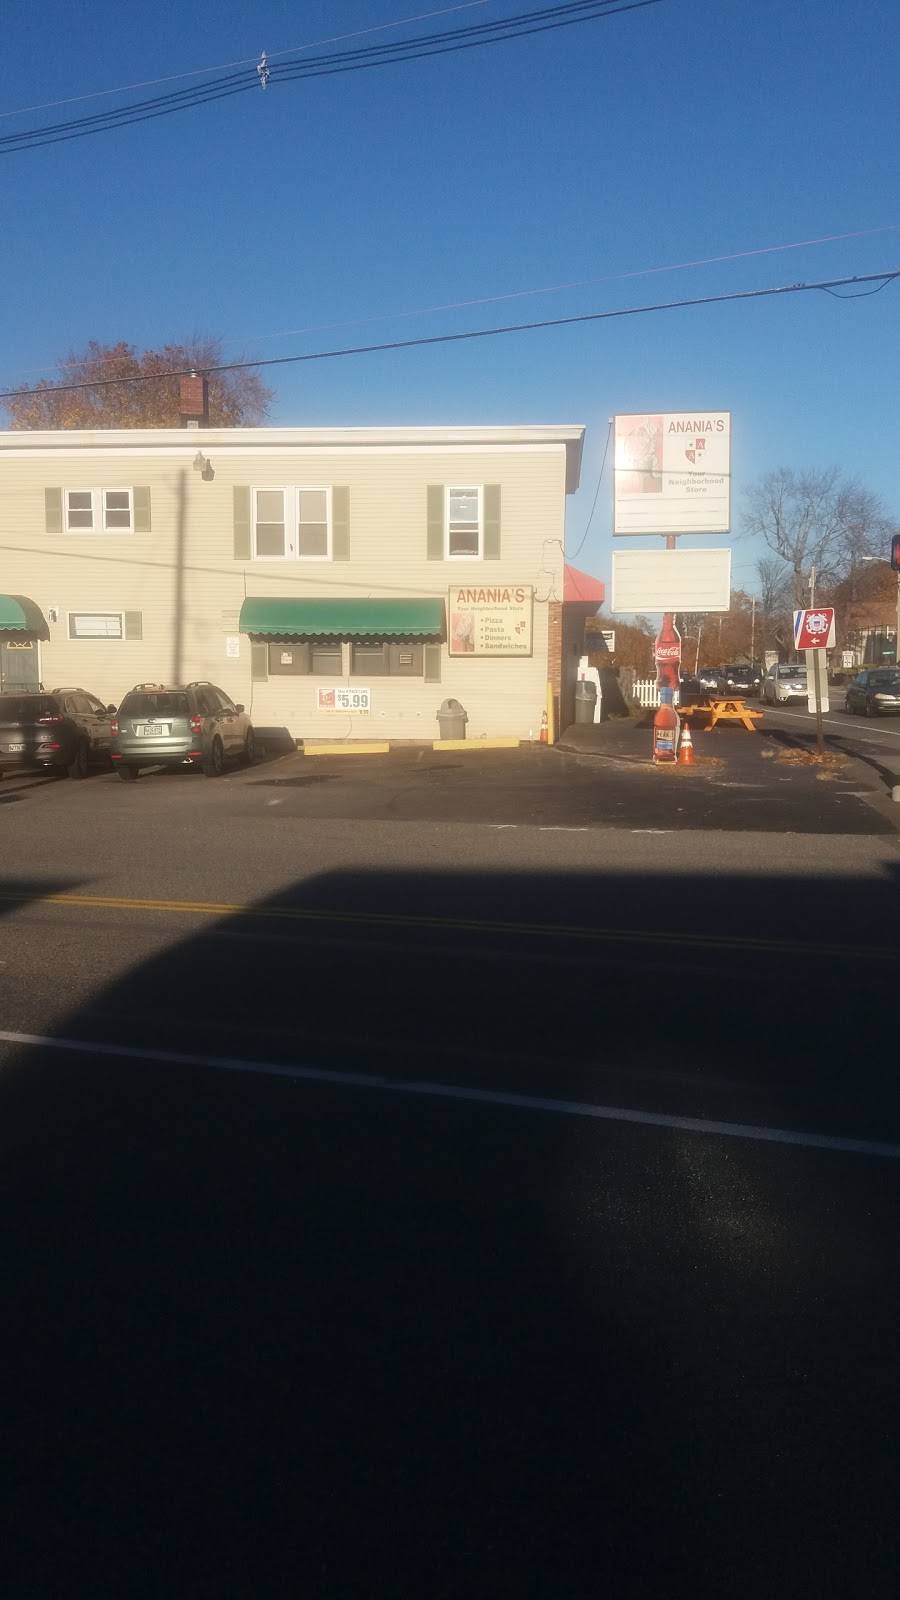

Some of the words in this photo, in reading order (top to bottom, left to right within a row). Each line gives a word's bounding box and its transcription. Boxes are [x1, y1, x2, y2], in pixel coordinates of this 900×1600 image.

[668, 419, 724, 433] ANANIA'S
[457, 588, 526, 603] ANANIA'S
[337, 694, 369, 708] $5.99
